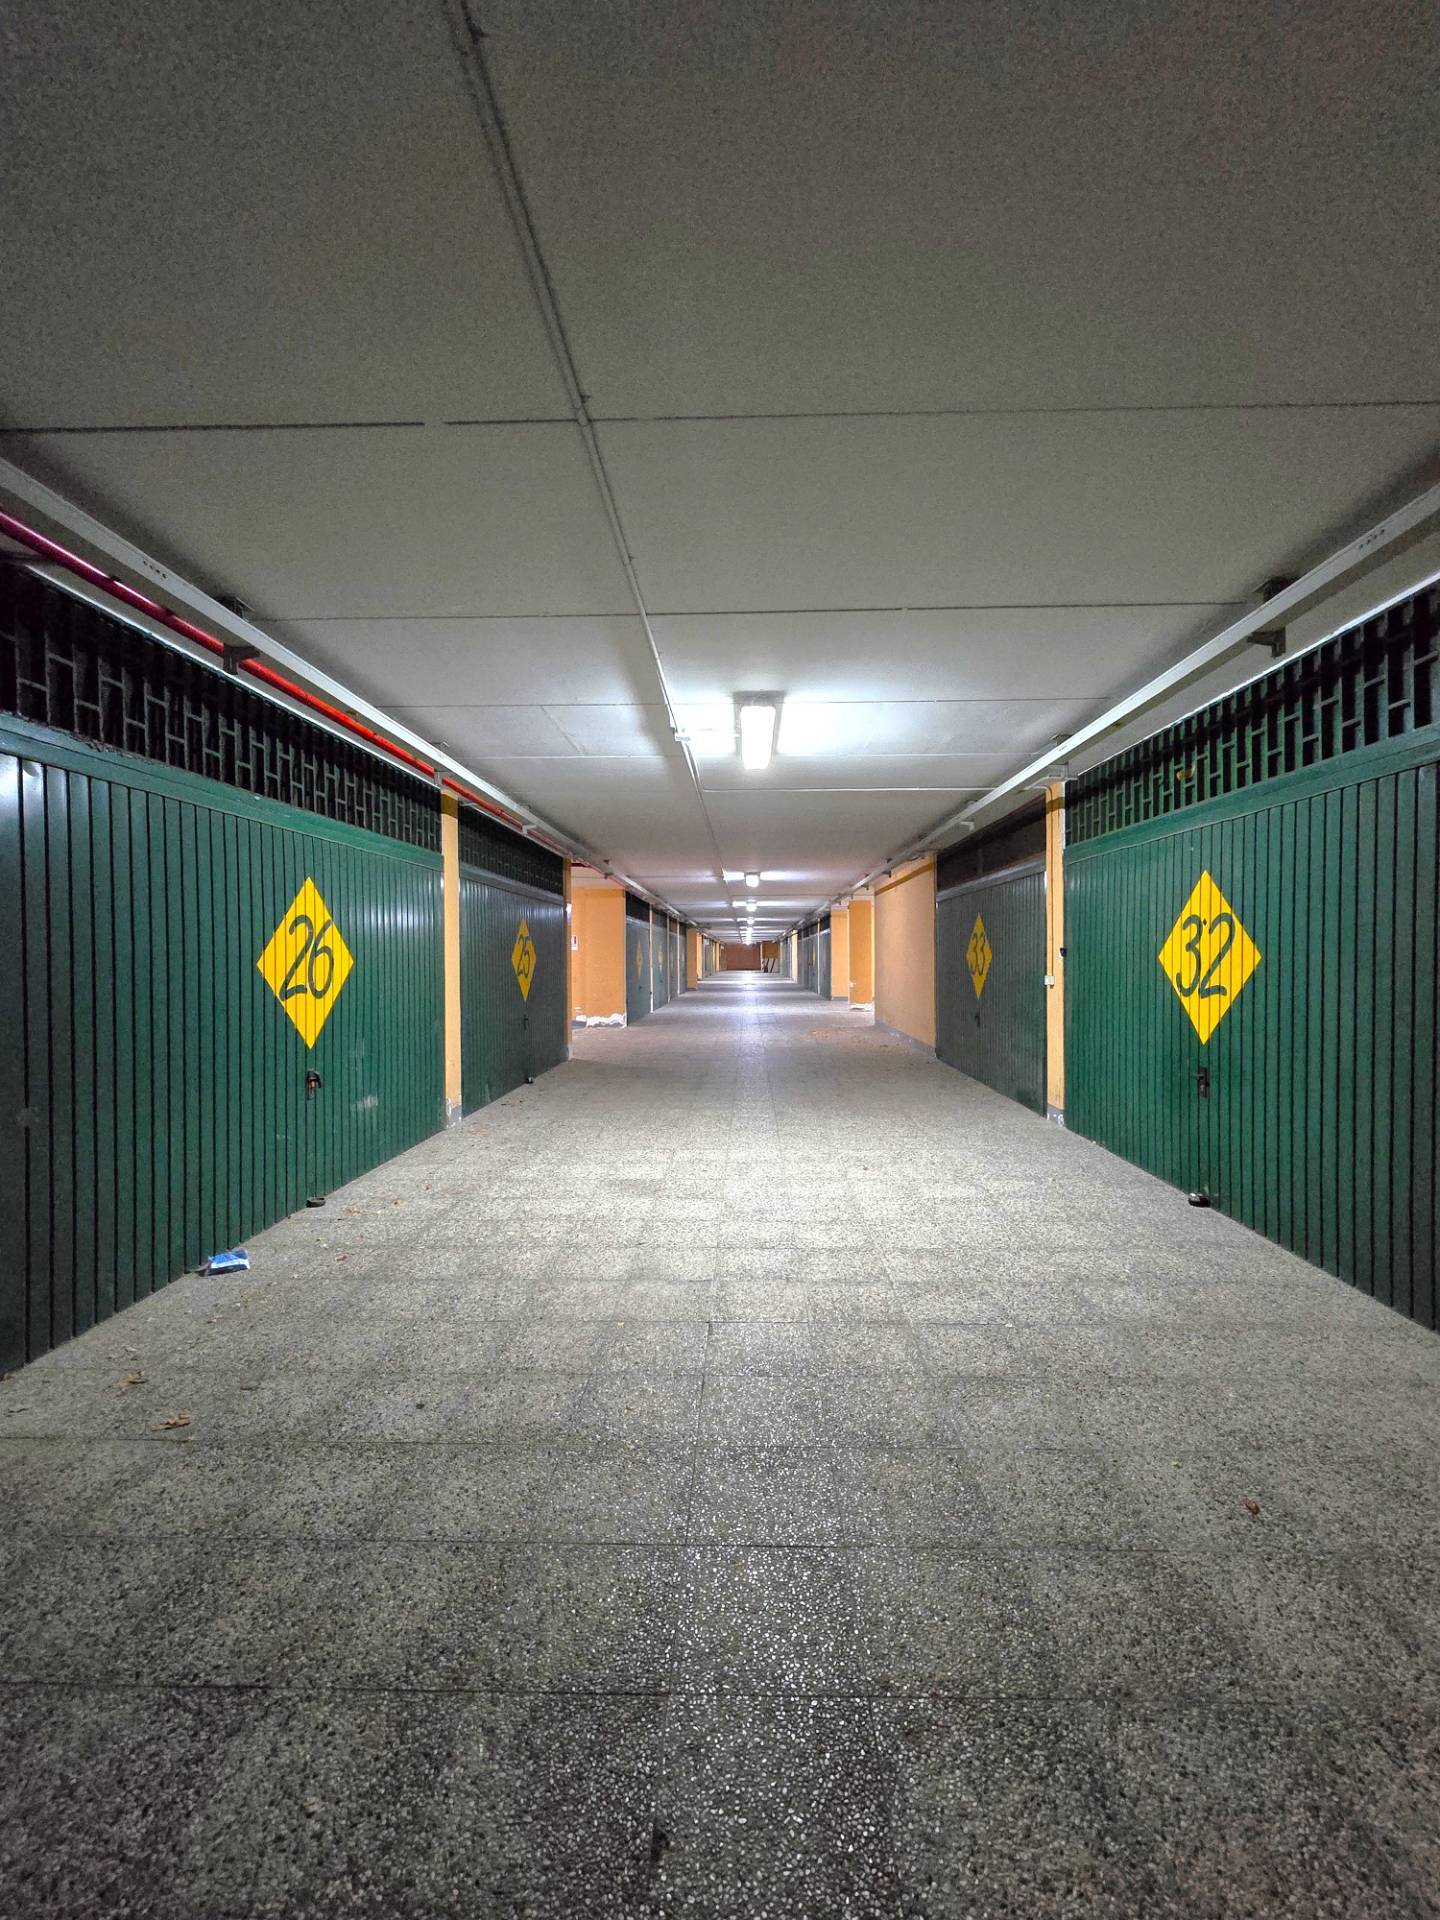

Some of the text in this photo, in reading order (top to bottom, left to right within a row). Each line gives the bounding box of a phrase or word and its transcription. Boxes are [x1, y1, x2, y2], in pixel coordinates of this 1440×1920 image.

[278, 914, 334, 1002] 26
[970, 932, 986, 976] 33
[1175, 912, 1236, 999] 32
